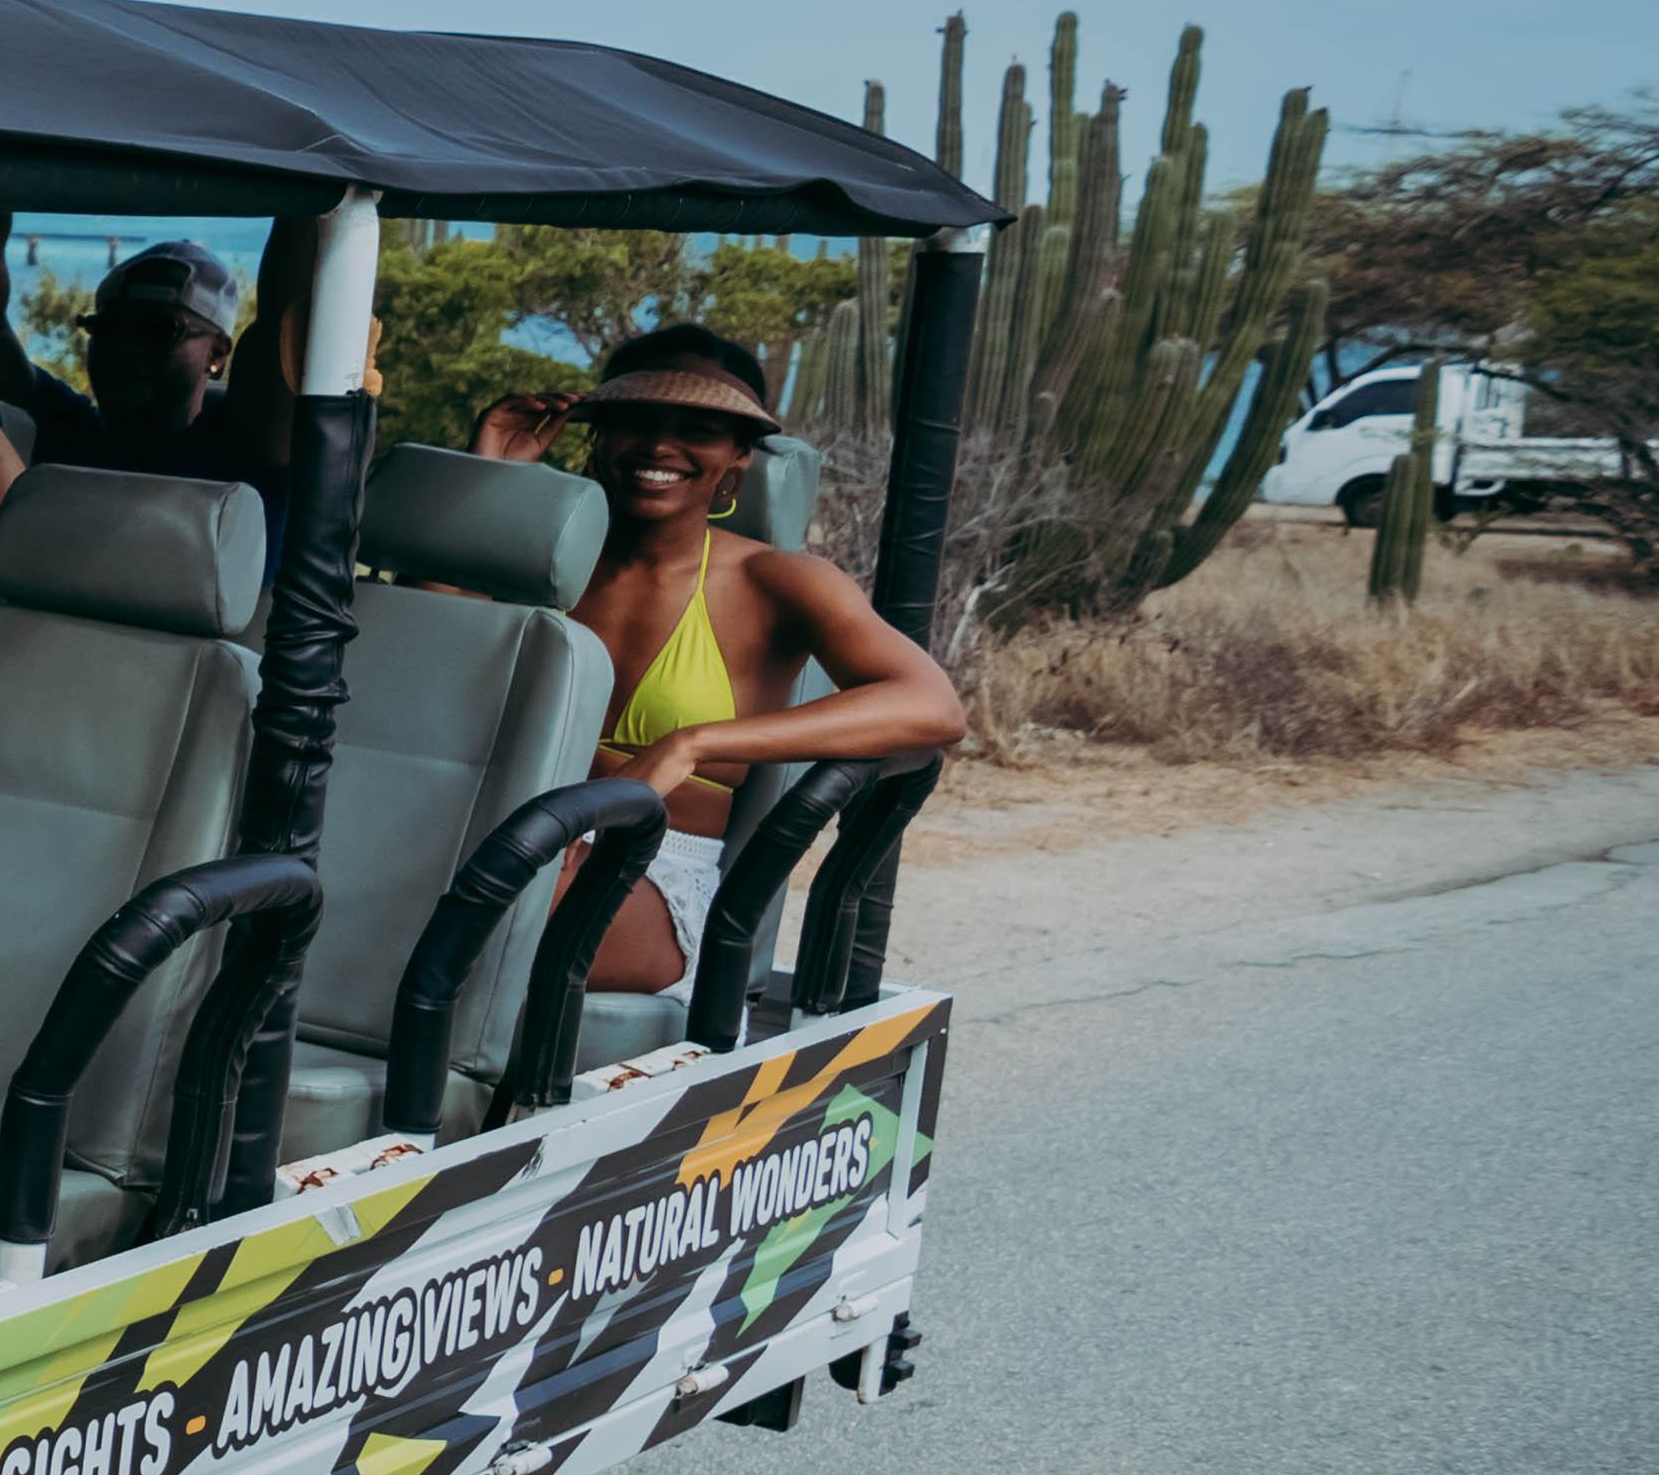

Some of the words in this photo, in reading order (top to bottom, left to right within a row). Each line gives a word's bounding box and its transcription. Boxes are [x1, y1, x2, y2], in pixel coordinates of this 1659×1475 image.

[216, 1297, 415, 1450] AMAZING
[421, 1247, 544, 1364] VIEWS
[571, 1185, 719, 1301] NATURAL
[730, 1117, 873, 1234] WONDERS
